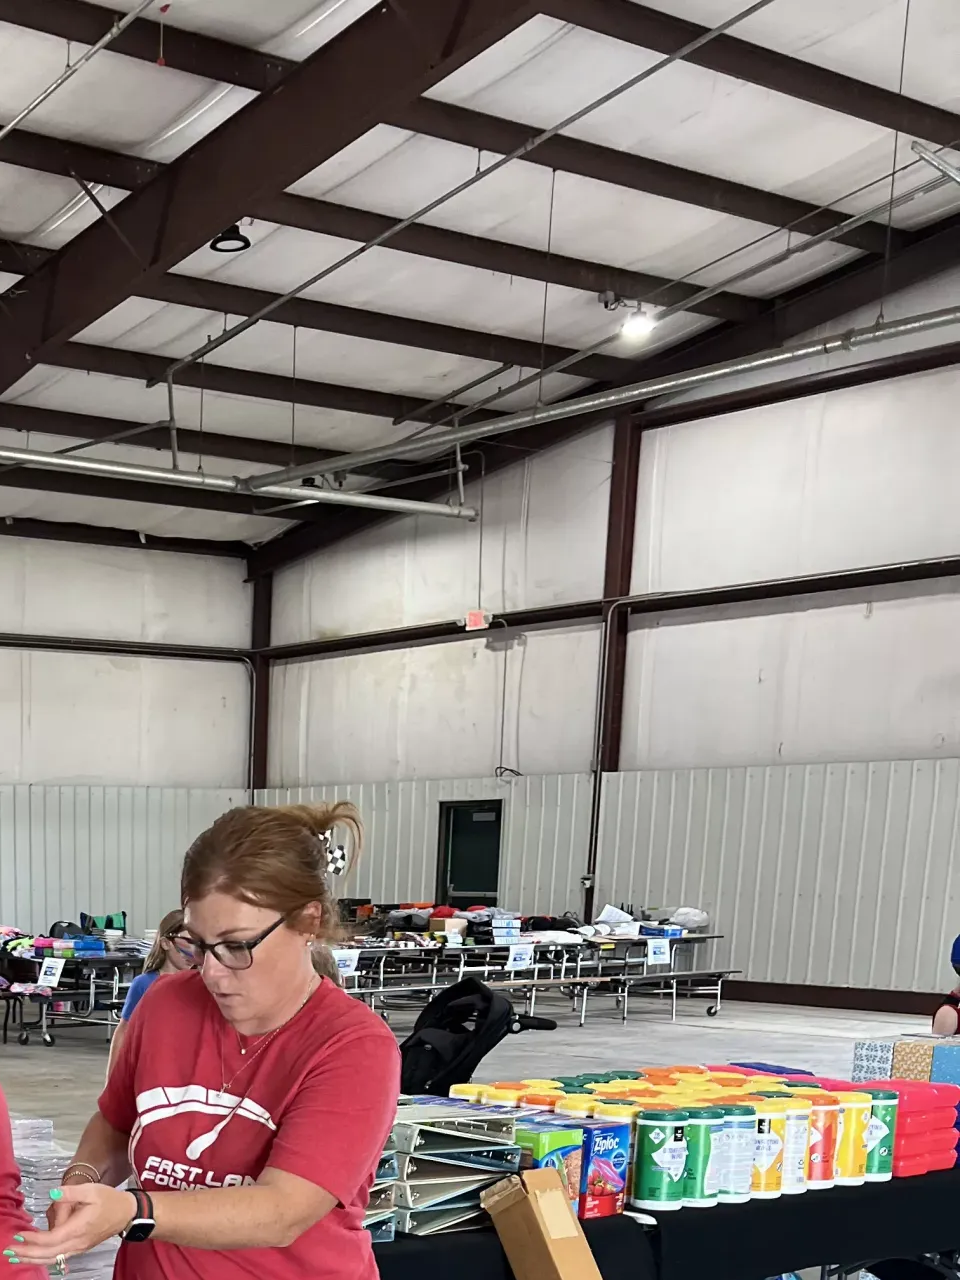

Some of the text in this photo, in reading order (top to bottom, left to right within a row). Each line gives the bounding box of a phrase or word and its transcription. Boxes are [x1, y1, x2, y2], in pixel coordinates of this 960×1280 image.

[593, 1135, 620, 1155] Ziploc
[144, 1155, 258, 1189] FAST LAN
